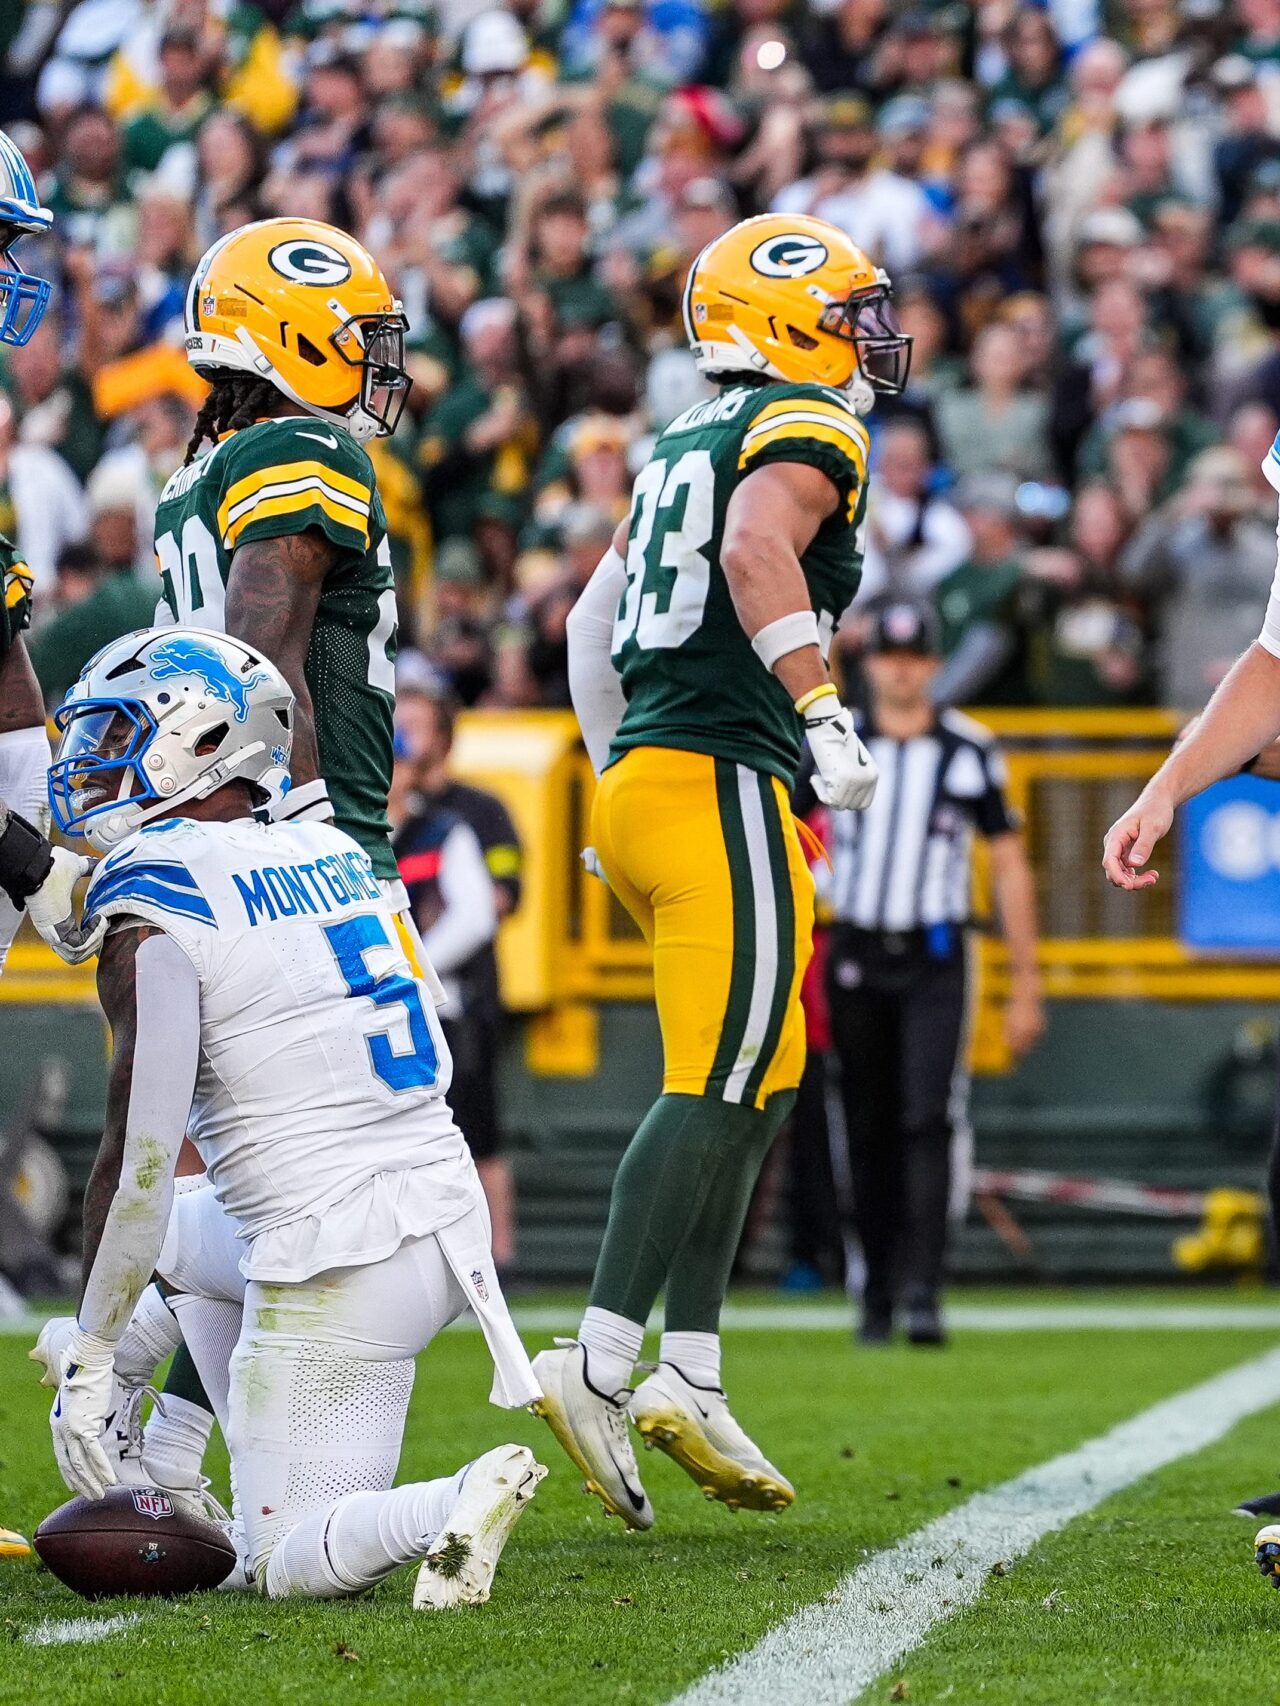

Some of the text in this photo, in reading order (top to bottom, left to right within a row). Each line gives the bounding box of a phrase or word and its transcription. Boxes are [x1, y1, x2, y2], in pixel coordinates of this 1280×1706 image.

[268, 239, 352, 287] G
[749, 233, 828, 279] G
[231, 852, 384, 927] MONTGOMER
[318, 911, 441, 1096] 5
[138, 1495, 170, 1512] NFL
